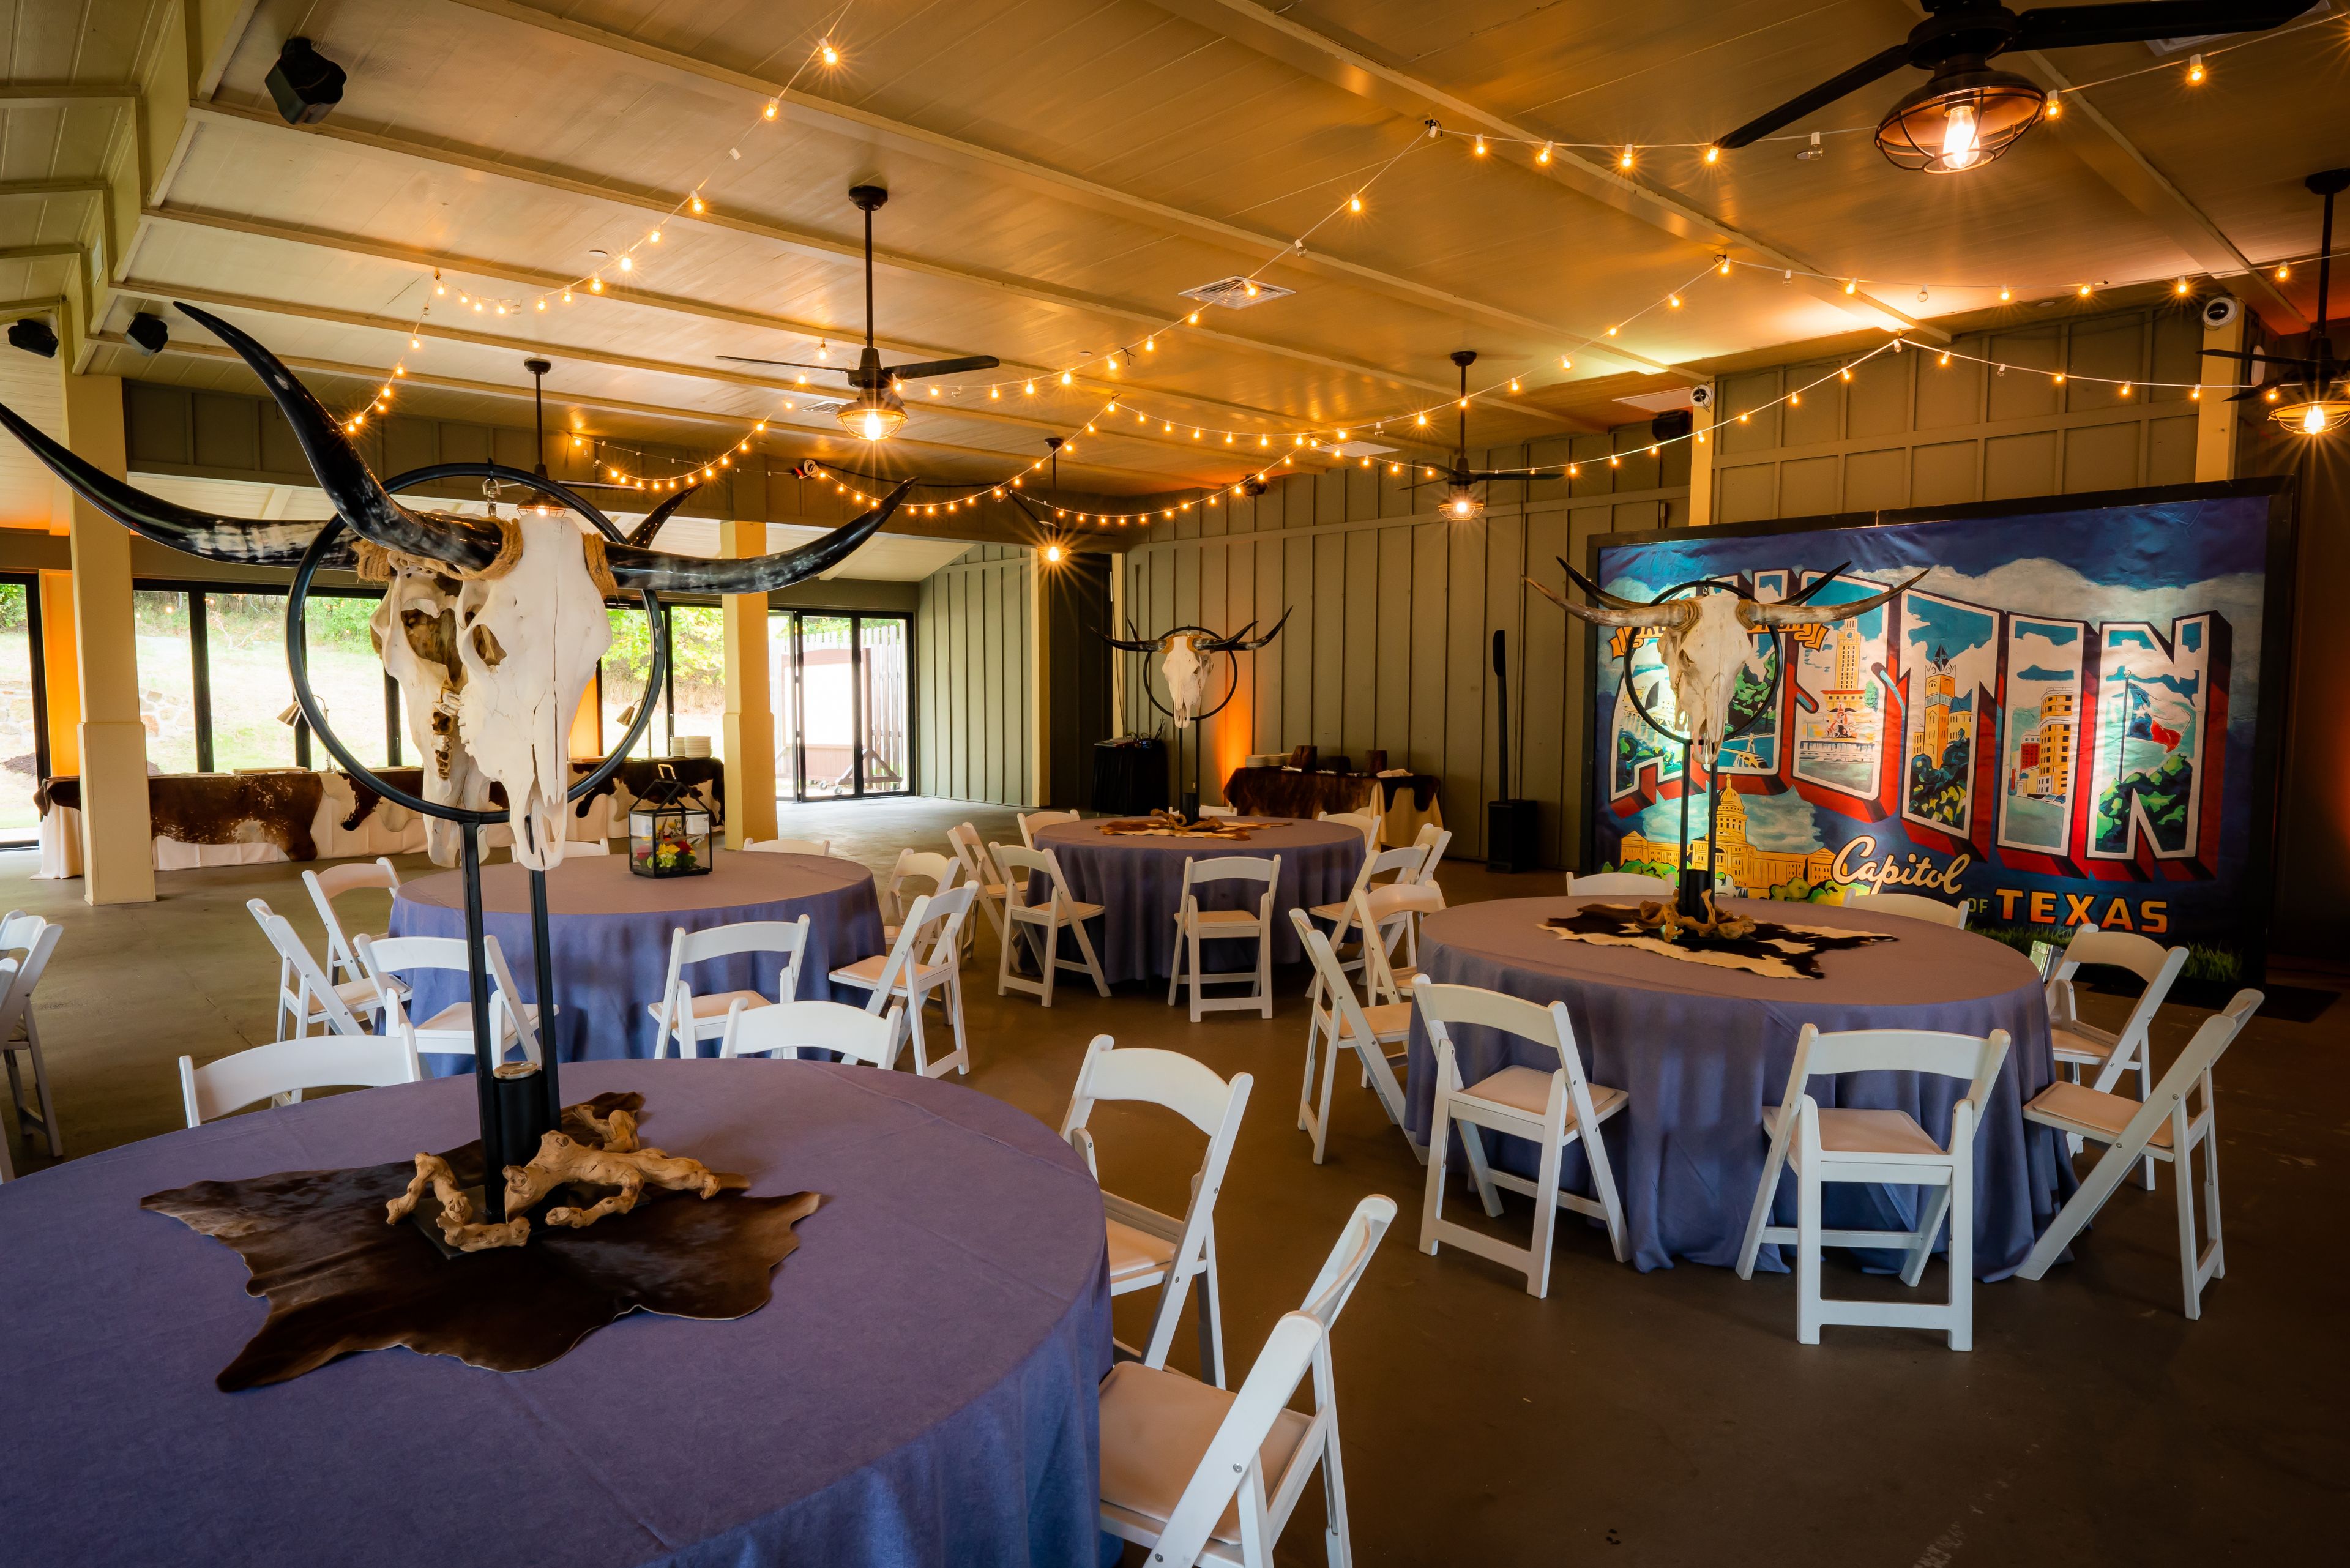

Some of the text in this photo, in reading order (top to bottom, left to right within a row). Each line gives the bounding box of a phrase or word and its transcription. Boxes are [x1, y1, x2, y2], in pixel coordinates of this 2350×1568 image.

[1832, 835, 2168, 934] Capitol OF TEXAS
